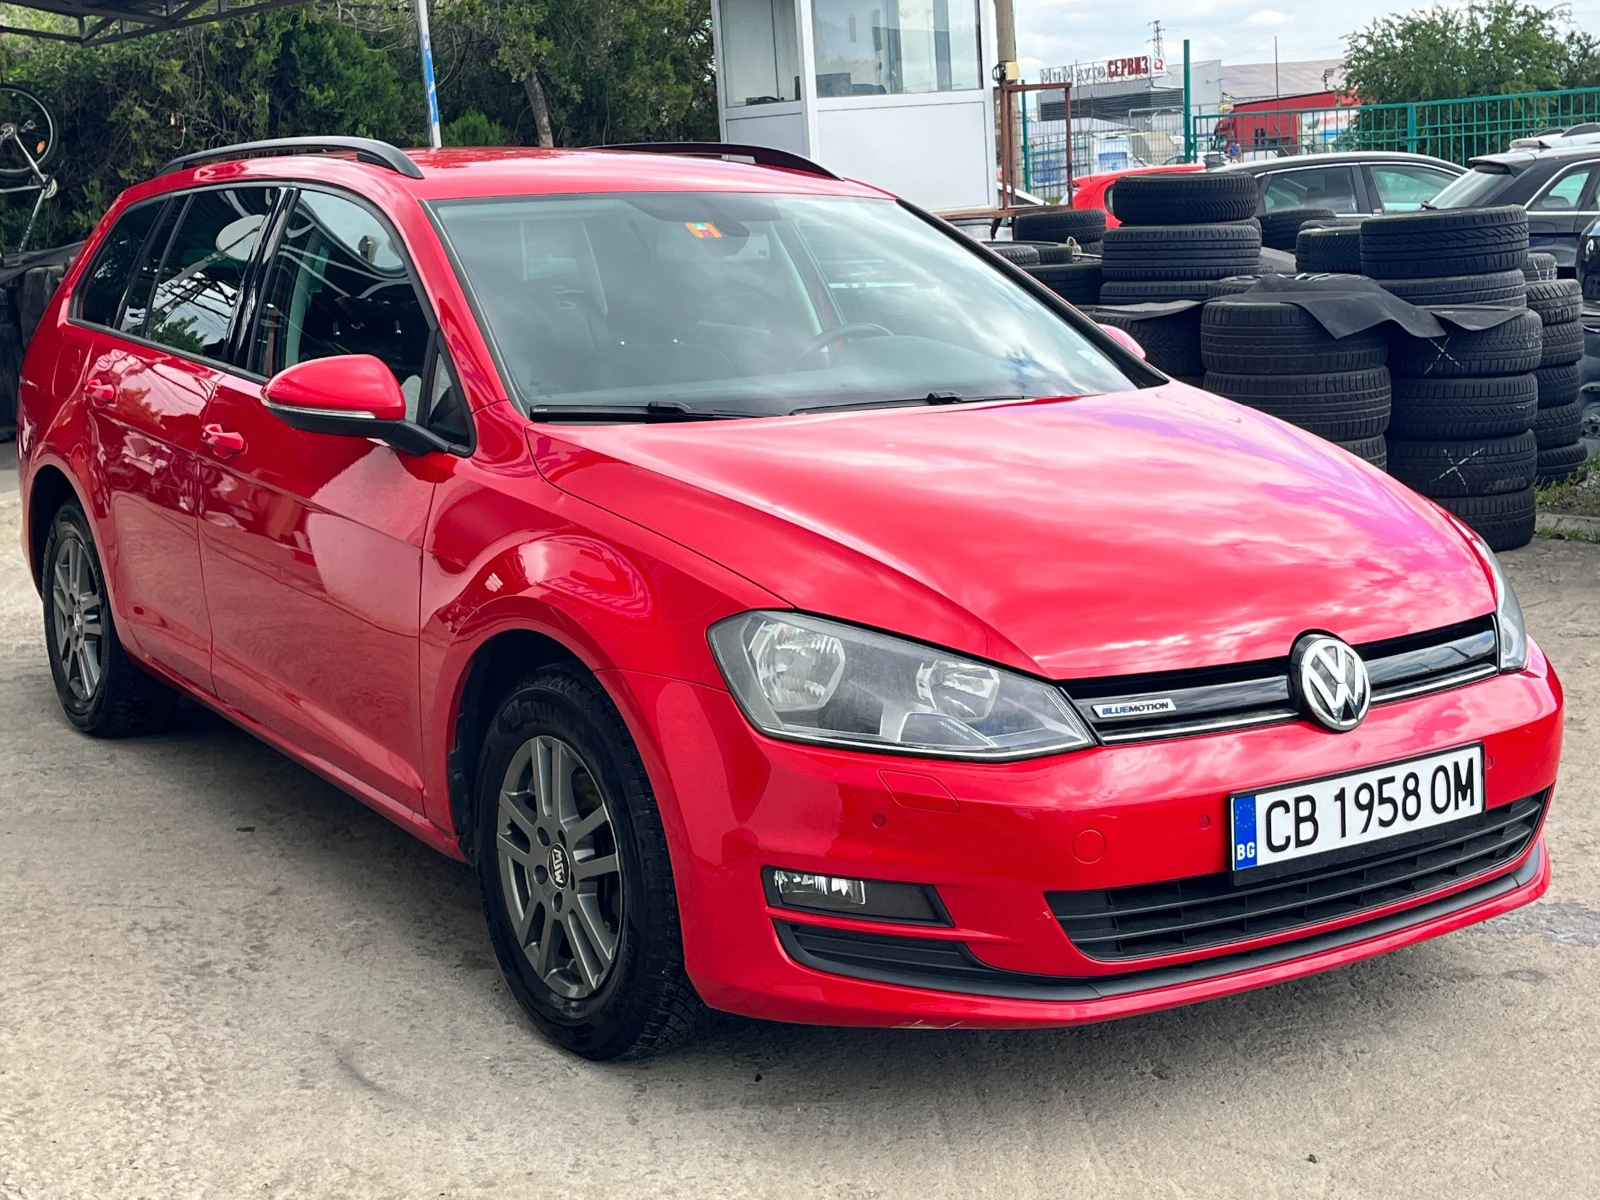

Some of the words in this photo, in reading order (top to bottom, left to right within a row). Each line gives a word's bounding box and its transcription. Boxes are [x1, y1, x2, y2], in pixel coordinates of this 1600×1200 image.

[1107, 56, 1149, 78] СЕРВИЗ
[1102, 702, 1169, 715] BLUEMOTION
[1265, 794, 1319, 853] CB
[1333, 772, 1422, 839] 1958
[1430, 757, 1475, 815] OM
[1236, 842, 1256, 861] BG
